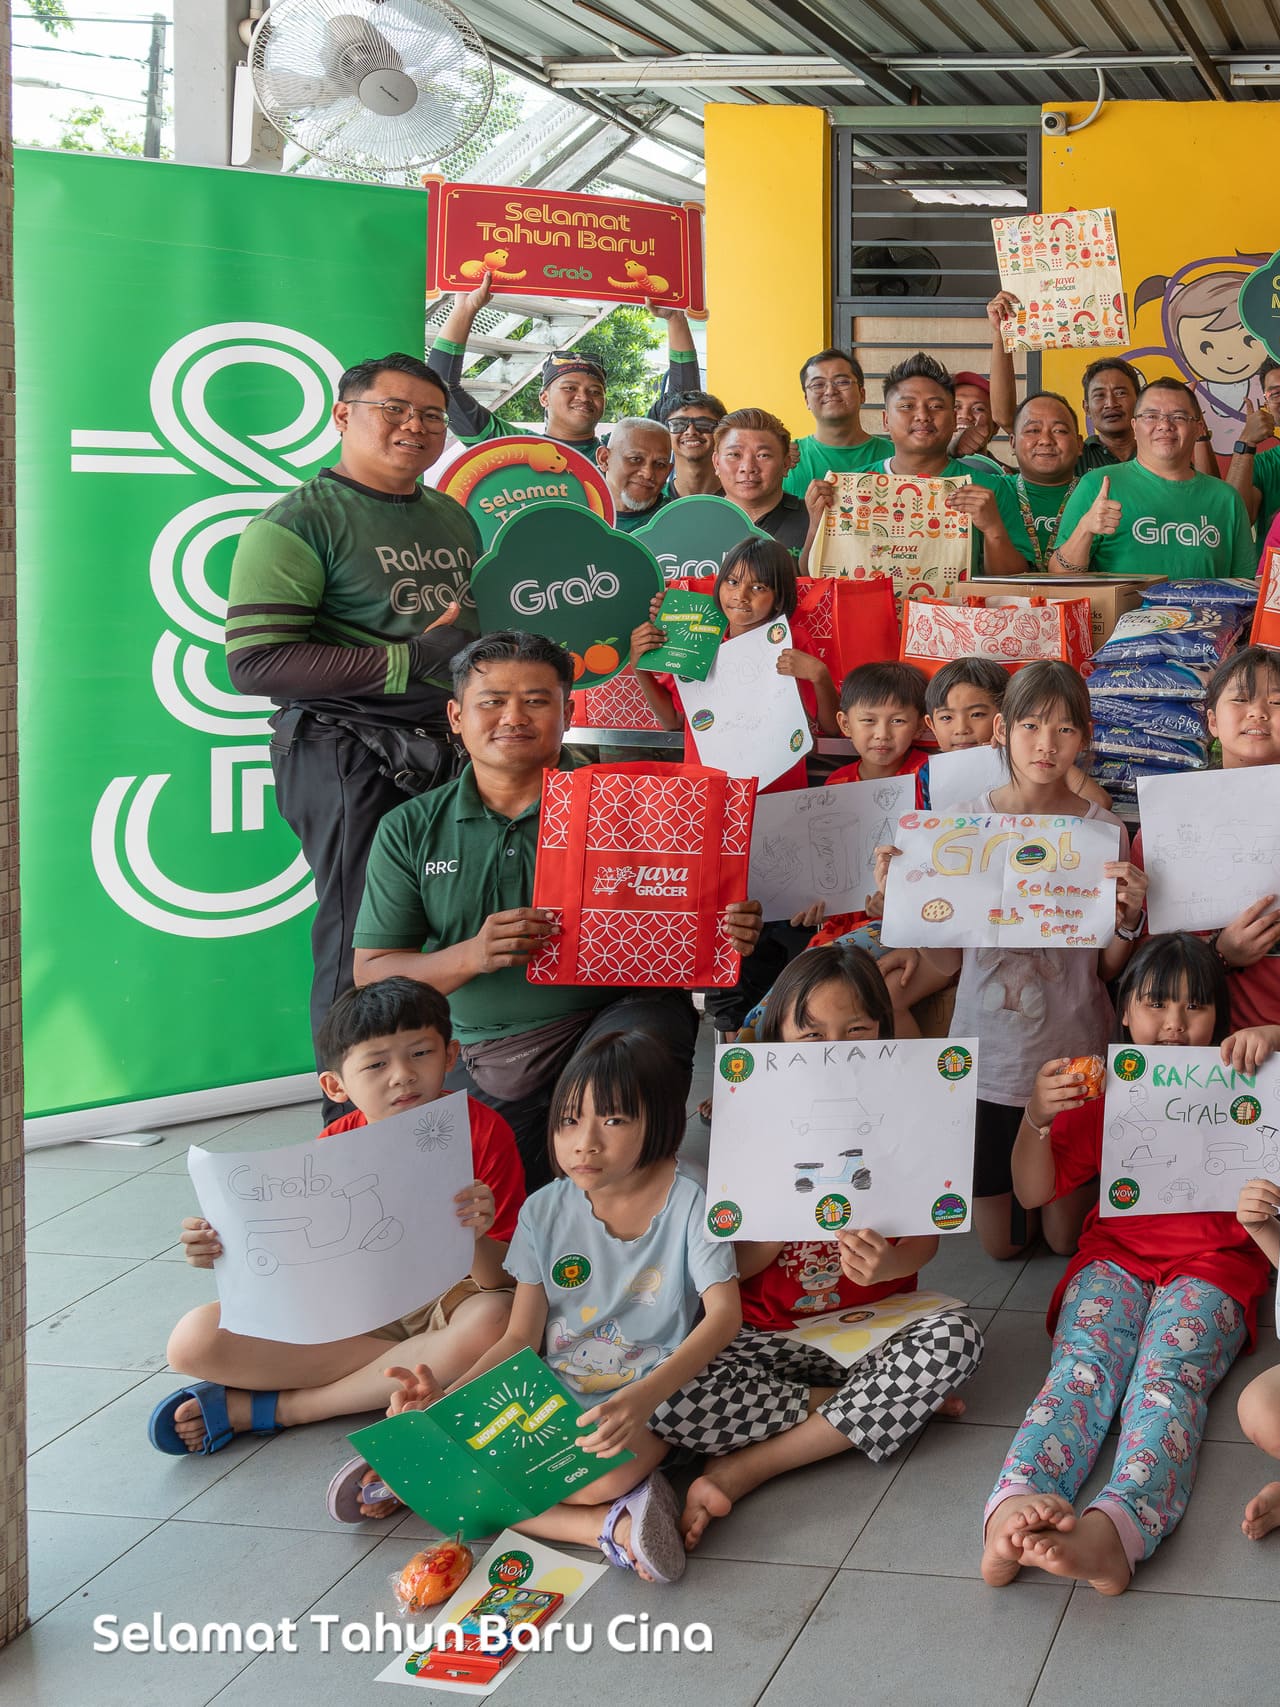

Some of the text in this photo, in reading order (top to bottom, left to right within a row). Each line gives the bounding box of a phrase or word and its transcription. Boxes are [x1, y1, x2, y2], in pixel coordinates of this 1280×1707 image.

[504, 202, 631, 233] Selamat
[476, 221, 656, 257] Tahun Baru!
[542, 264, 592, 282] Grab
[1052, 275, 1076, 288] Jaya
[479, 483, 568, 514] Selamat
[1132, 514, 1221, 549] Grab
[375, 541, 472, 574] Rakan
[887, 544, 919, 555] Jaya
[656, 551, 729, 580] Gra
[510, 564, 620, 616] Grab
[71, 322, 347, 938] Grab
[665, 661, 681, 669] Grab
[931, 826, 1081, 876] Grab
[425, 860, 459, 876] RRC
[628, 865, 689, 888] Jaya
[766, 1043, 898, 1072] RAKAN
[1152, 1063, 1257, 1090] RAKAN
[227, 1153, 333, 1202] Grab
[1111, 1188, 1138, 1198] WOW!
[710, 1212, 740, 1224] WOW!
[476, 1406, 519, 1446] HOW TO BE
[528, 1399, 559, 1430] A HERO
[564, 1467, 589, 1484] Grab
